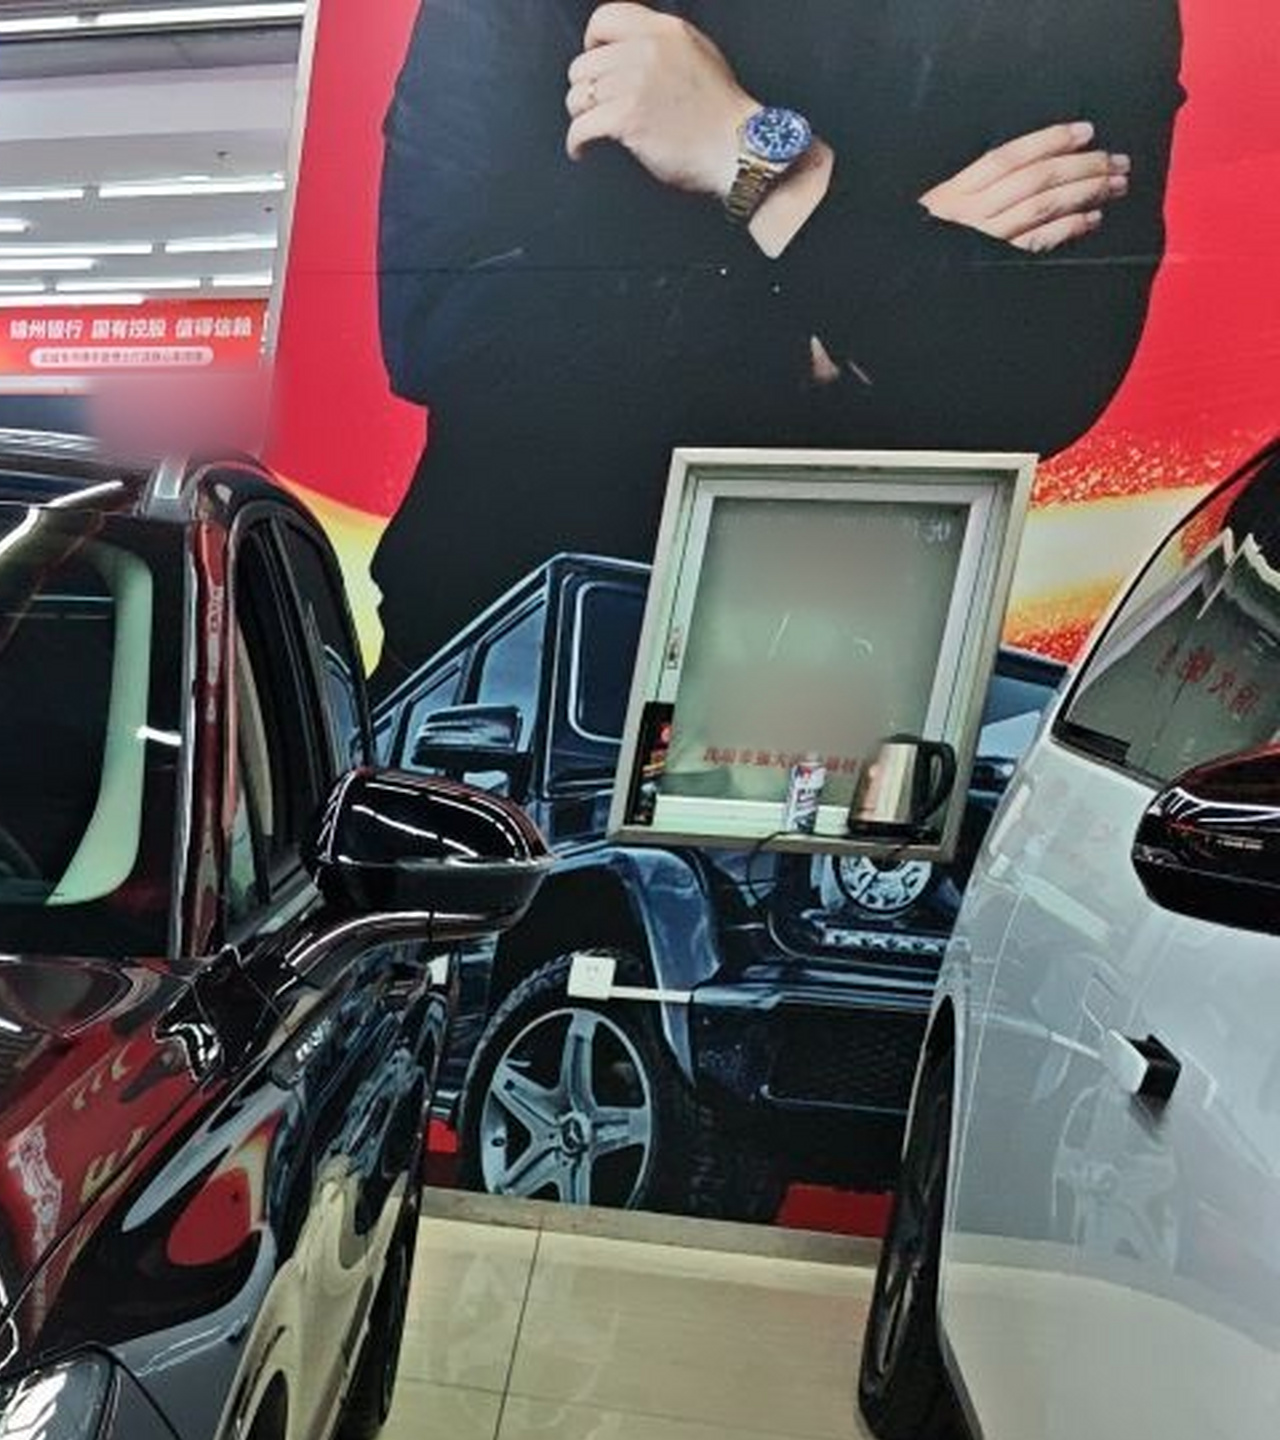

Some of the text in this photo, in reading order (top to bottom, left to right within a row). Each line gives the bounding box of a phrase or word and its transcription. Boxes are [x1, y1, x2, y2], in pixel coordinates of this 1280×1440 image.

[91, 318, 167, 340] 国有控股
[174, 316, 253, 339] 值得信赖
